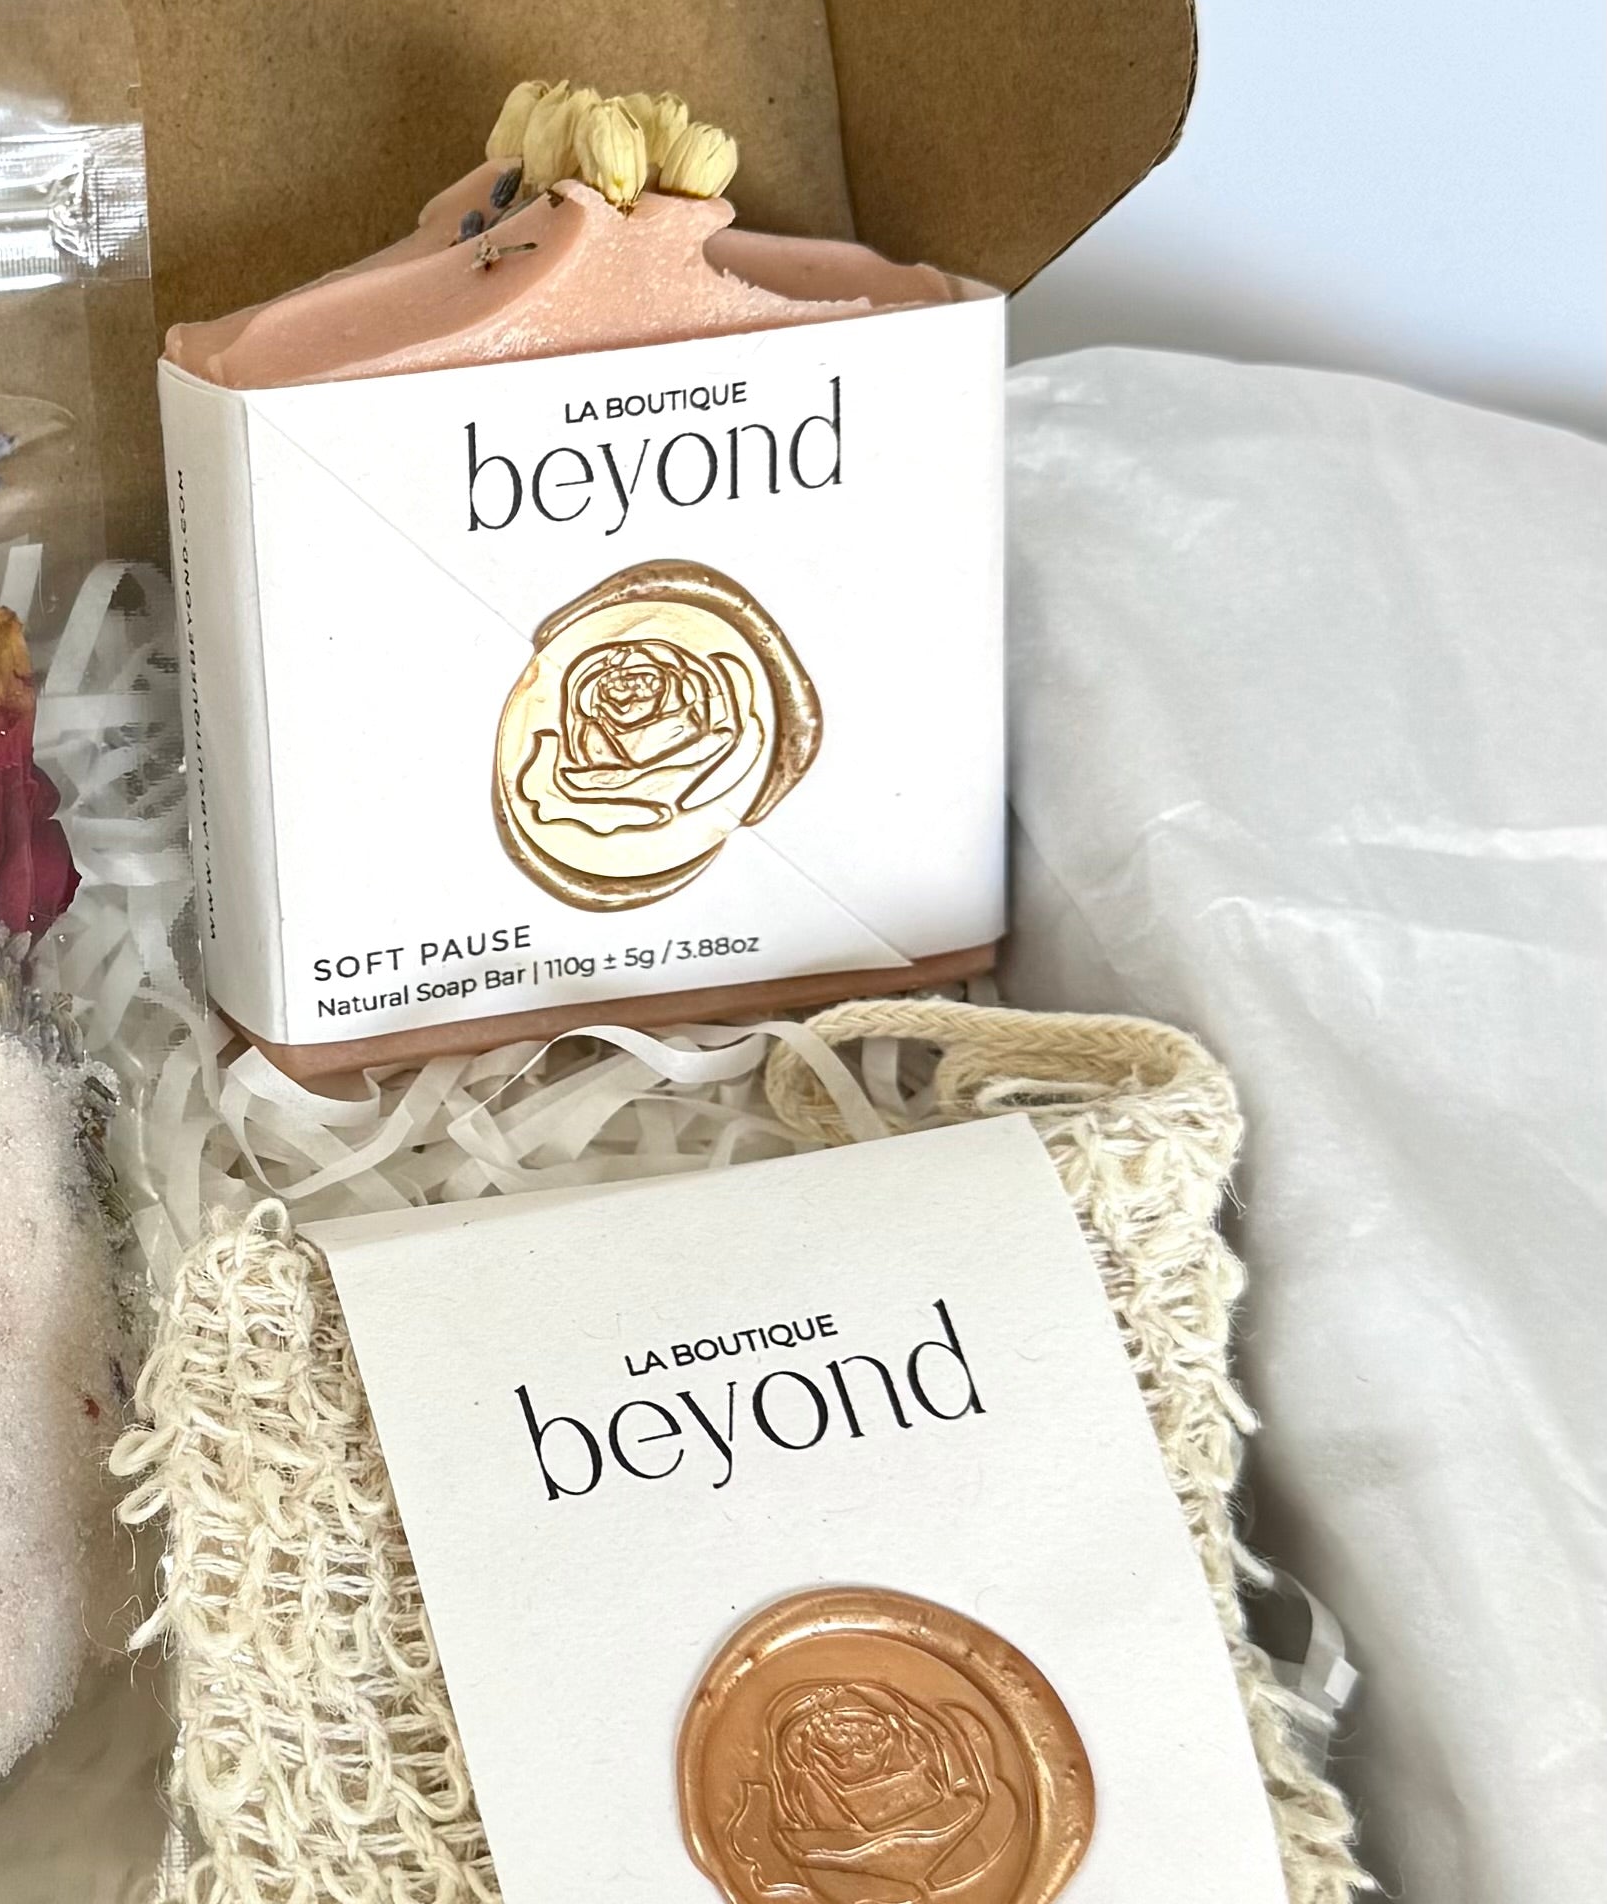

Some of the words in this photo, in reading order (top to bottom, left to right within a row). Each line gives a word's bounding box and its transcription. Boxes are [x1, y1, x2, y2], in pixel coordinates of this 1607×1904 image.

[565, 401, 599, 424] LA
[606, 381, 747, 419] BOUTIQUE
[464, 376, 842, 536] beyond
[314, 947, 404, 981] SOFT
[421, 925, 531, 966] PAUSE
[318, 985, 409, 1018] Natural
[416, 978, 478, 1002] Soap
[485, 963, 526, 989] Bar
[544, 957, 595, 979] 110g
[624, 1350, 669, 1376] LA
[671, 1313, 839, 1366] BOUTIQUE
[514, 1298, 986, 1501] beyond
